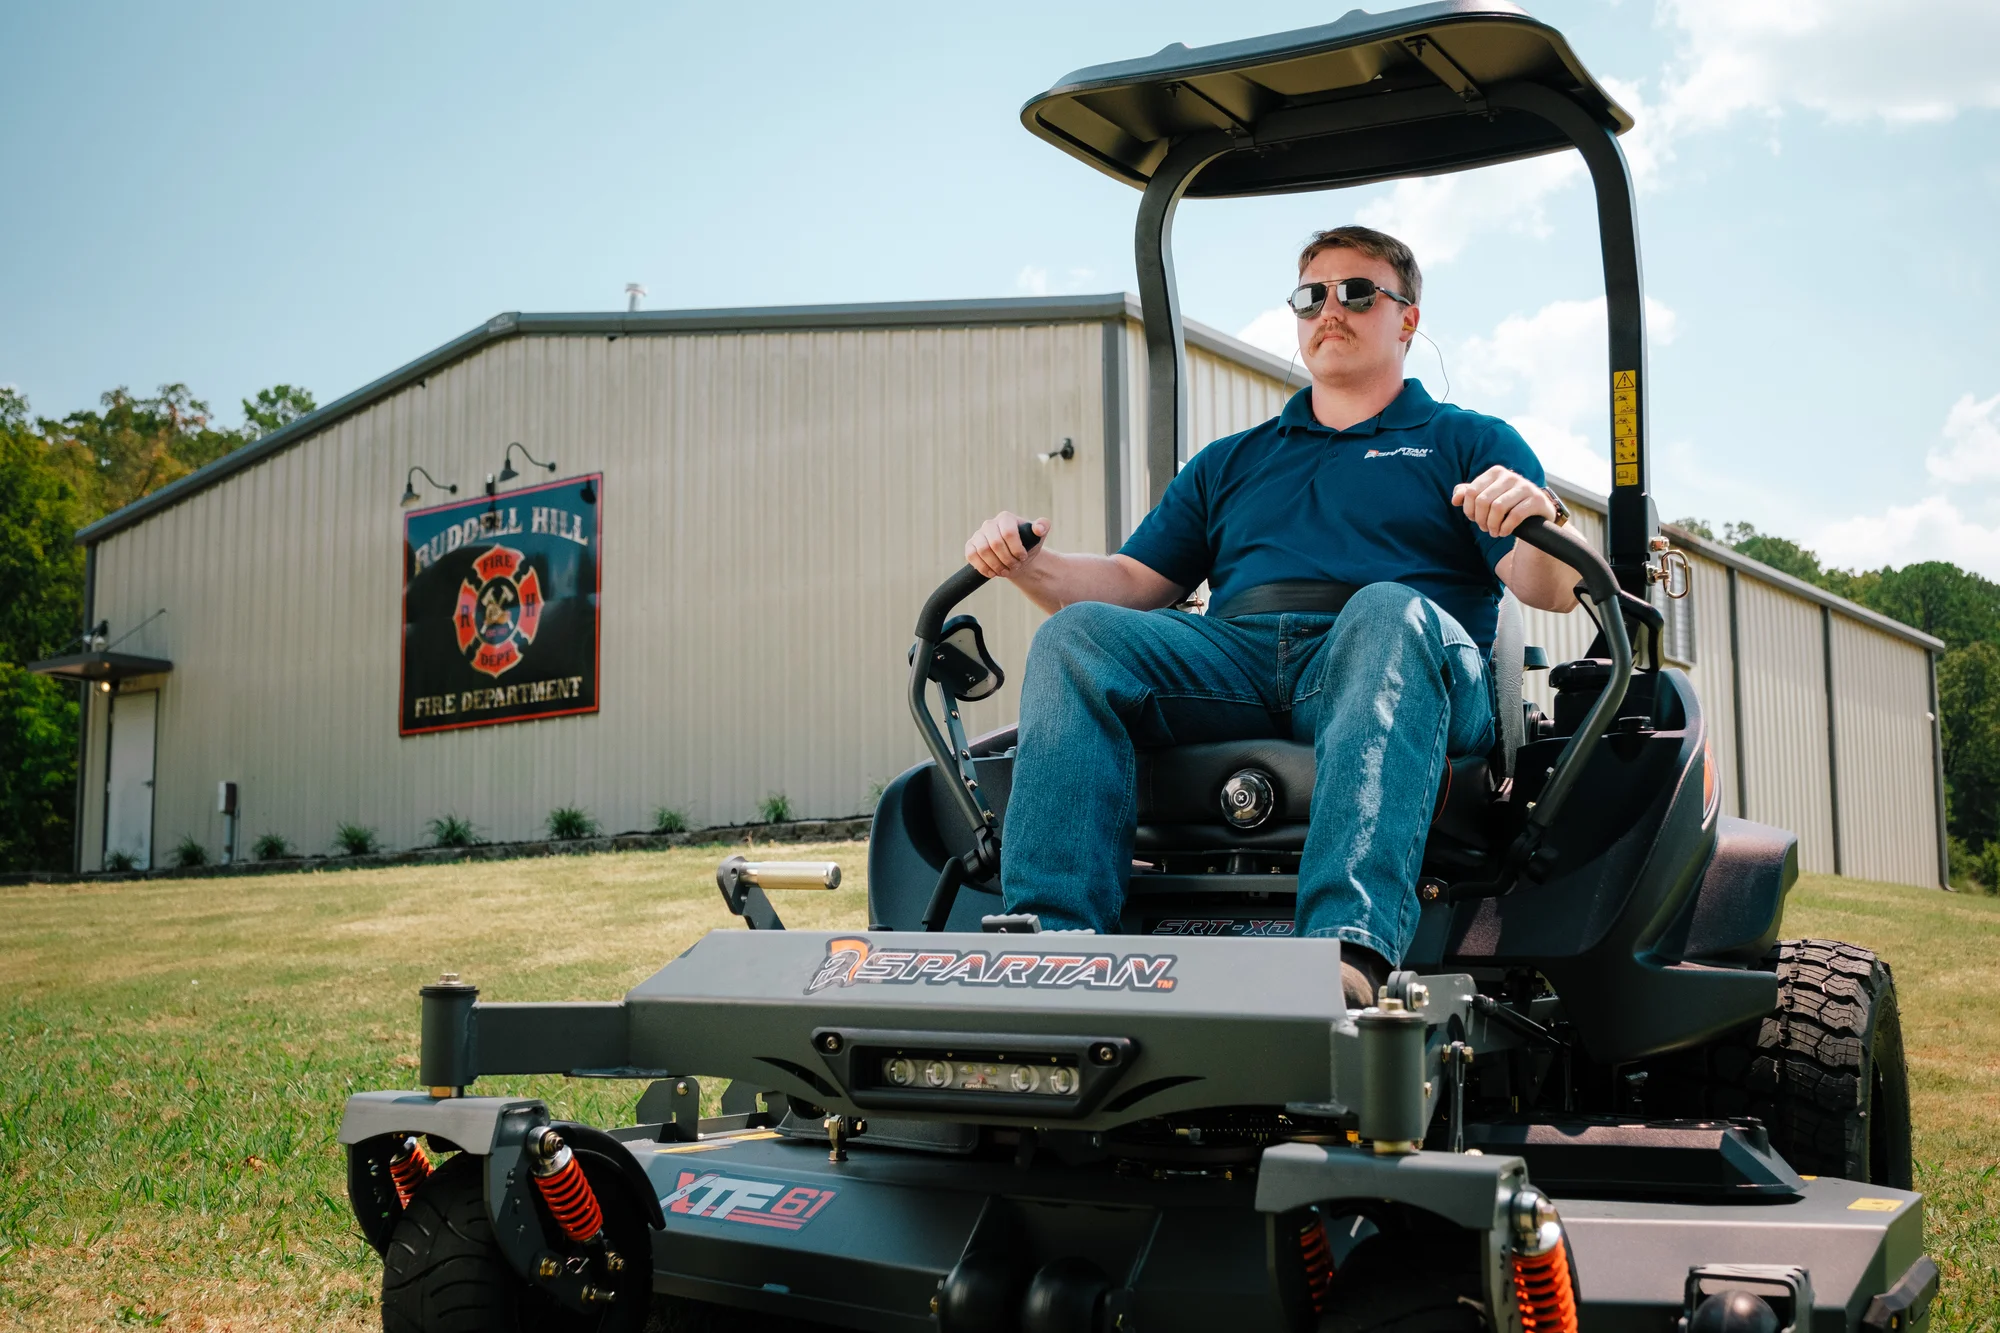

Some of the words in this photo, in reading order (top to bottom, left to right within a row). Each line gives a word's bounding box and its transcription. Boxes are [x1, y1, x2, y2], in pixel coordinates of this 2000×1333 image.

[414, 507, 523, 577] RUDDELL
[532, 506, 588, 547] HILL
[482, 555, 513, 574] FIRE
[415, 694, 456, 718] FIRE
[461, 676, 583, 712] DEPARTMENT
[854, 952, 1172, 988] SPARTAN
[770, 1187, 836, 1219] 61
